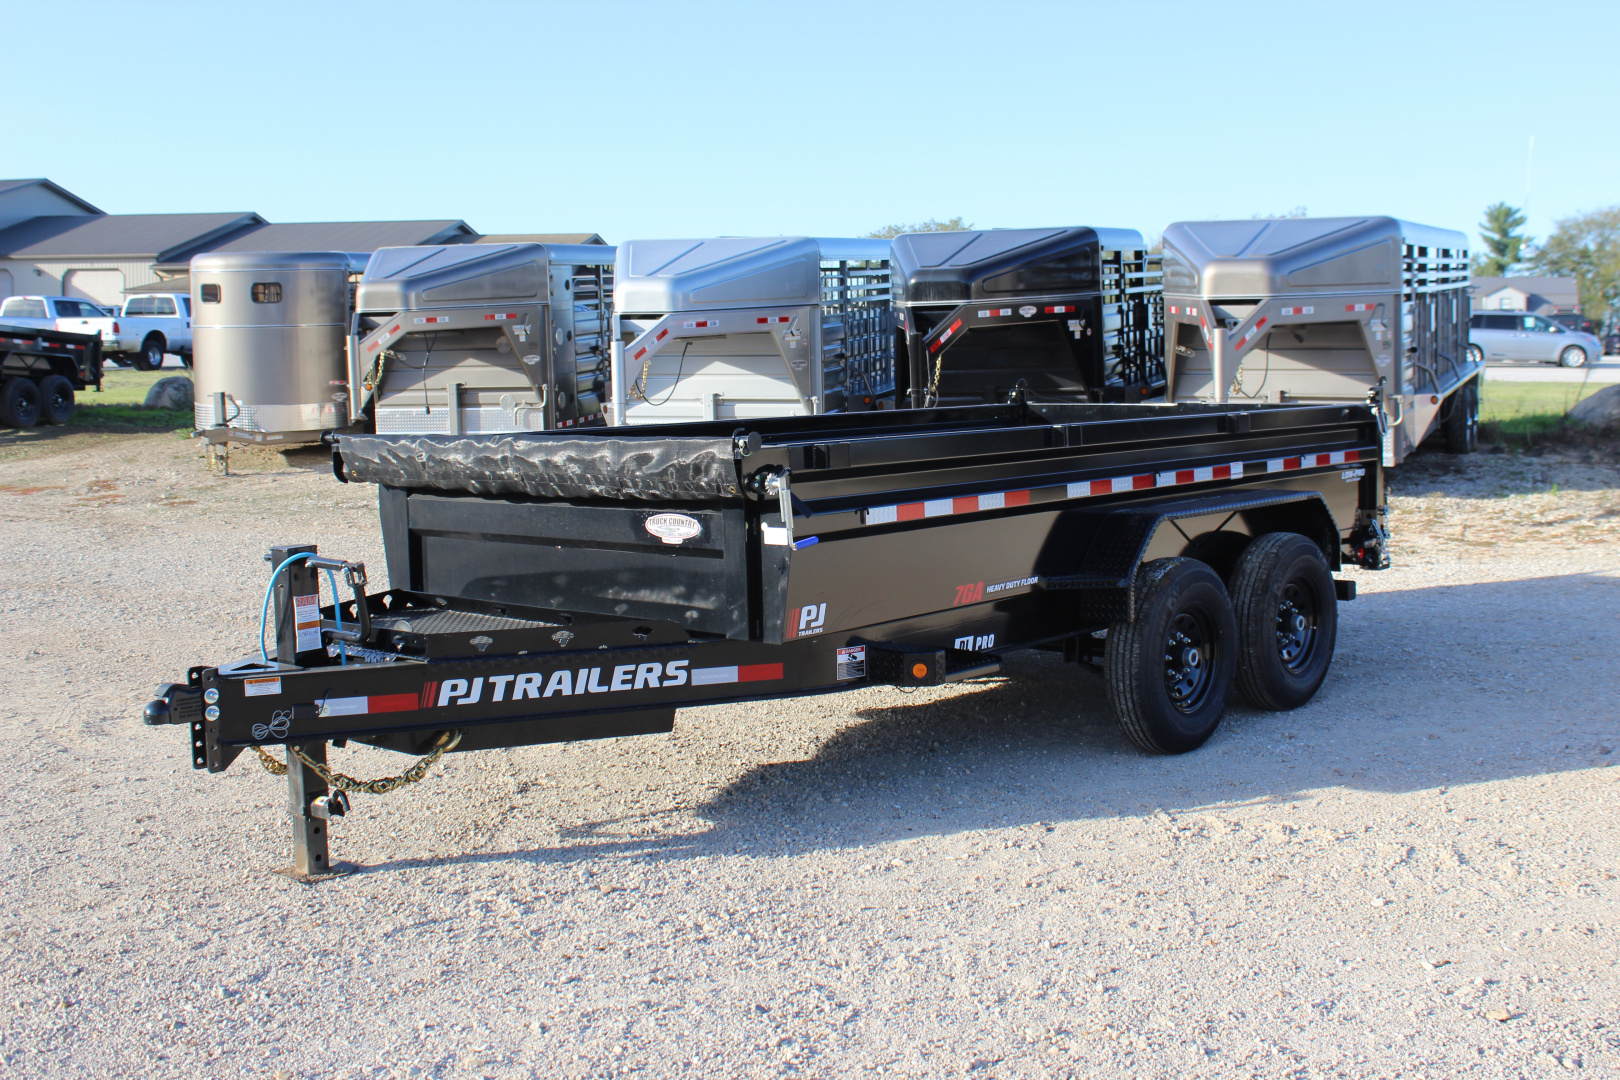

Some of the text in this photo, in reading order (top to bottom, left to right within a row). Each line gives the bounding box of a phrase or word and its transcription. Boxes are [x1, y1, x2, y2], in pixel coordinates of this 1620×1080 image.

[649, 517, 696, 528] TRUCK COUNTRY
[952, 576, 1039, 606] 7GA HEAVY DUTY FLOOR
[296, 597, 317, 607] RAM
[799, 602, 827, 629] PJ
[798, 627, 824, 637] TRAILERS
[975, 633, 995, 651] PRO
[487, 659, 690, 703] TRAILERS
